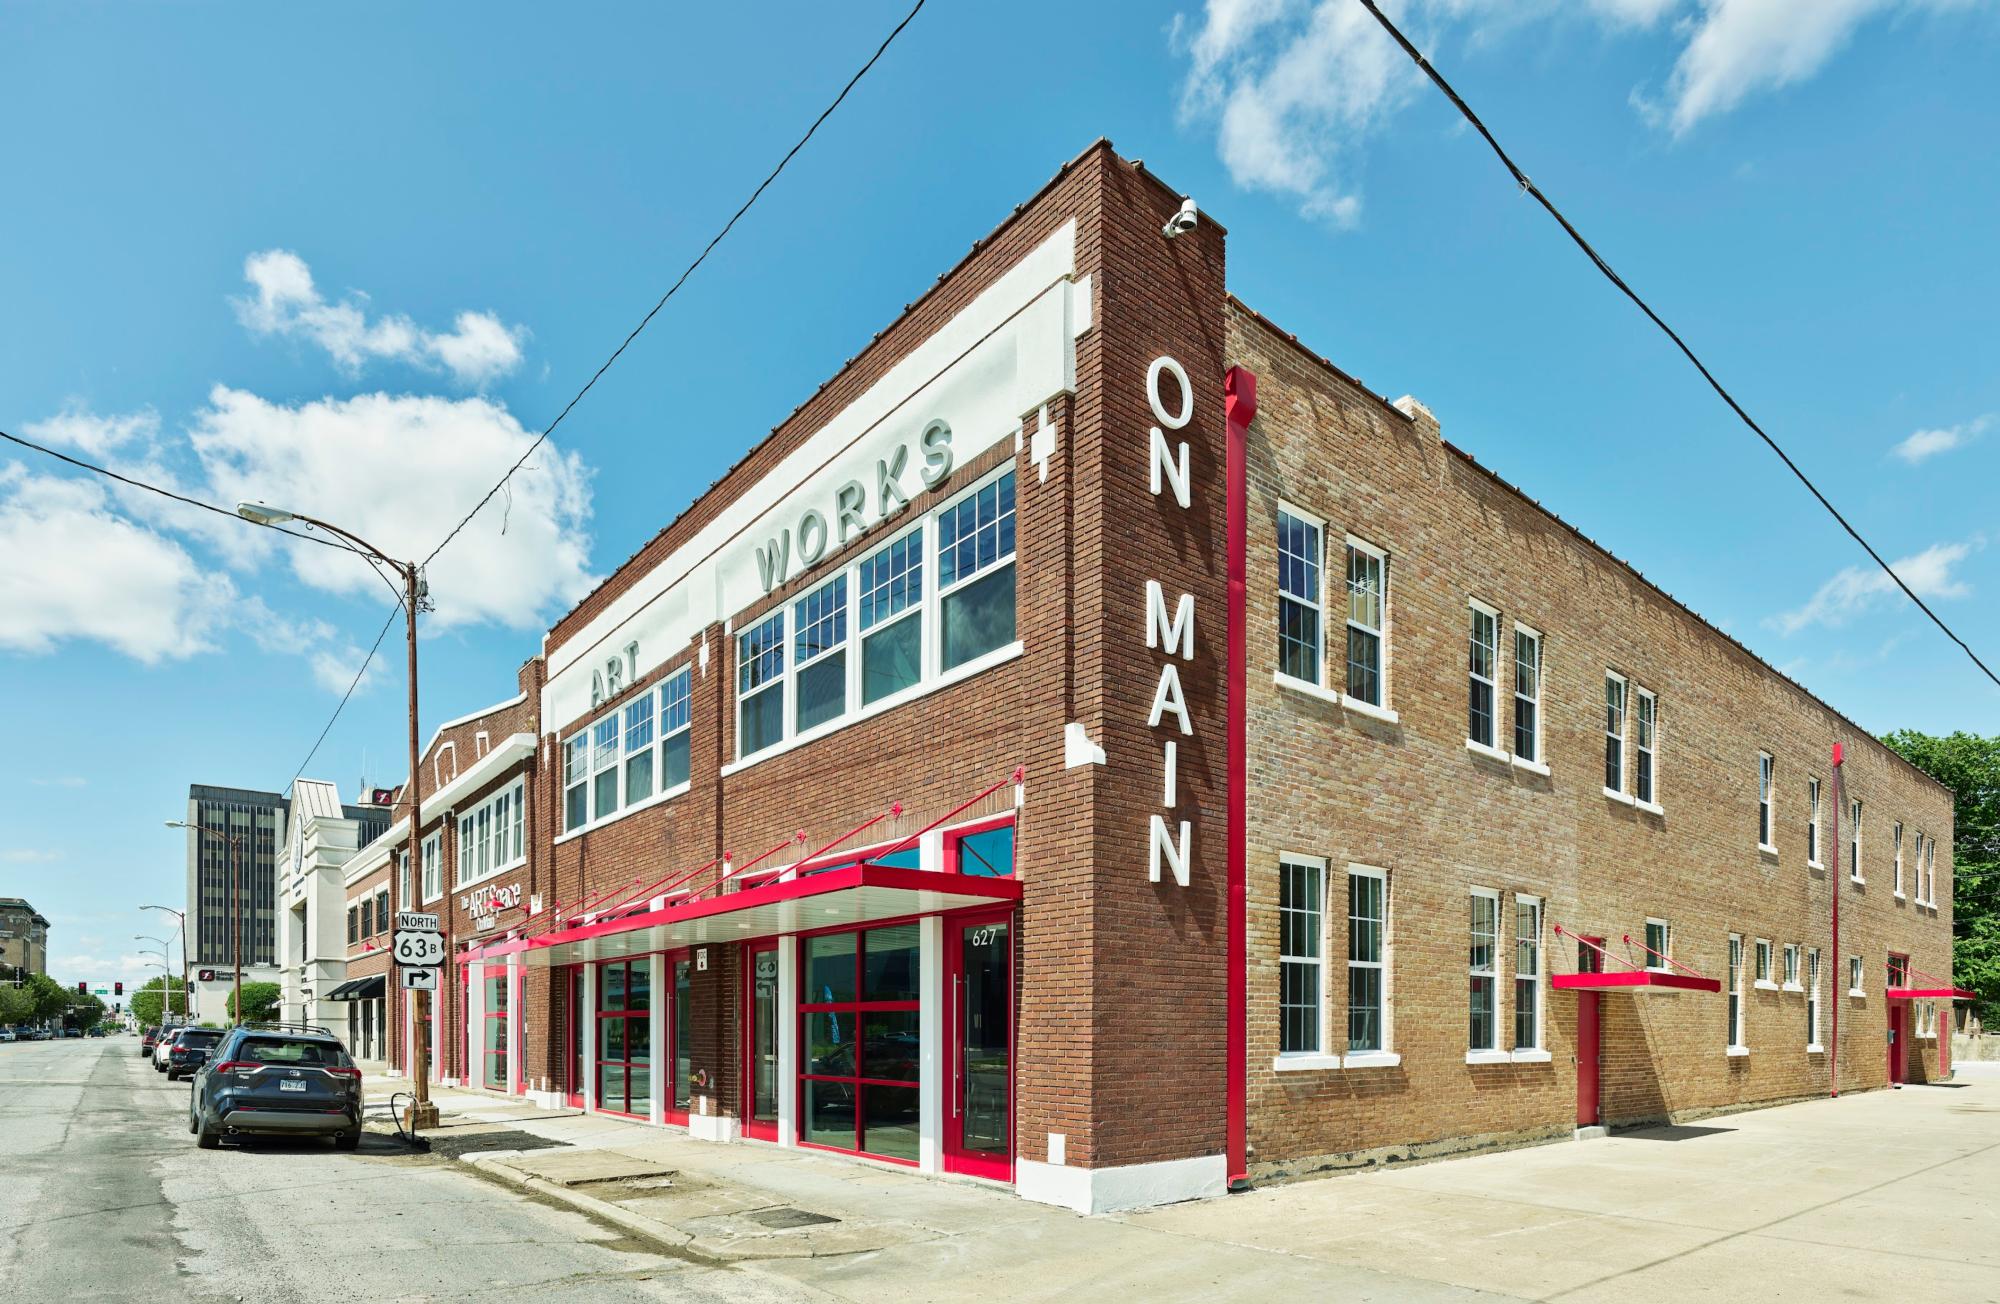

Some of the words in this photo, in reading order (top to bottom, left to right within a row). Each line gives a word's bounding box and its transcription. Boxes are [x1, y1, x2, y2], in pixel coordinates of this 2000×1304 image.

[1146, 356, 1193, 508] ON
[591, 640, 639, 707] ART
[755, 418, 953, 592] WORKS
[1146, 580, 1194, 887] MAIN
[401, 914, 437, 928] NORTH
[972, 928, 996, 946] 627
